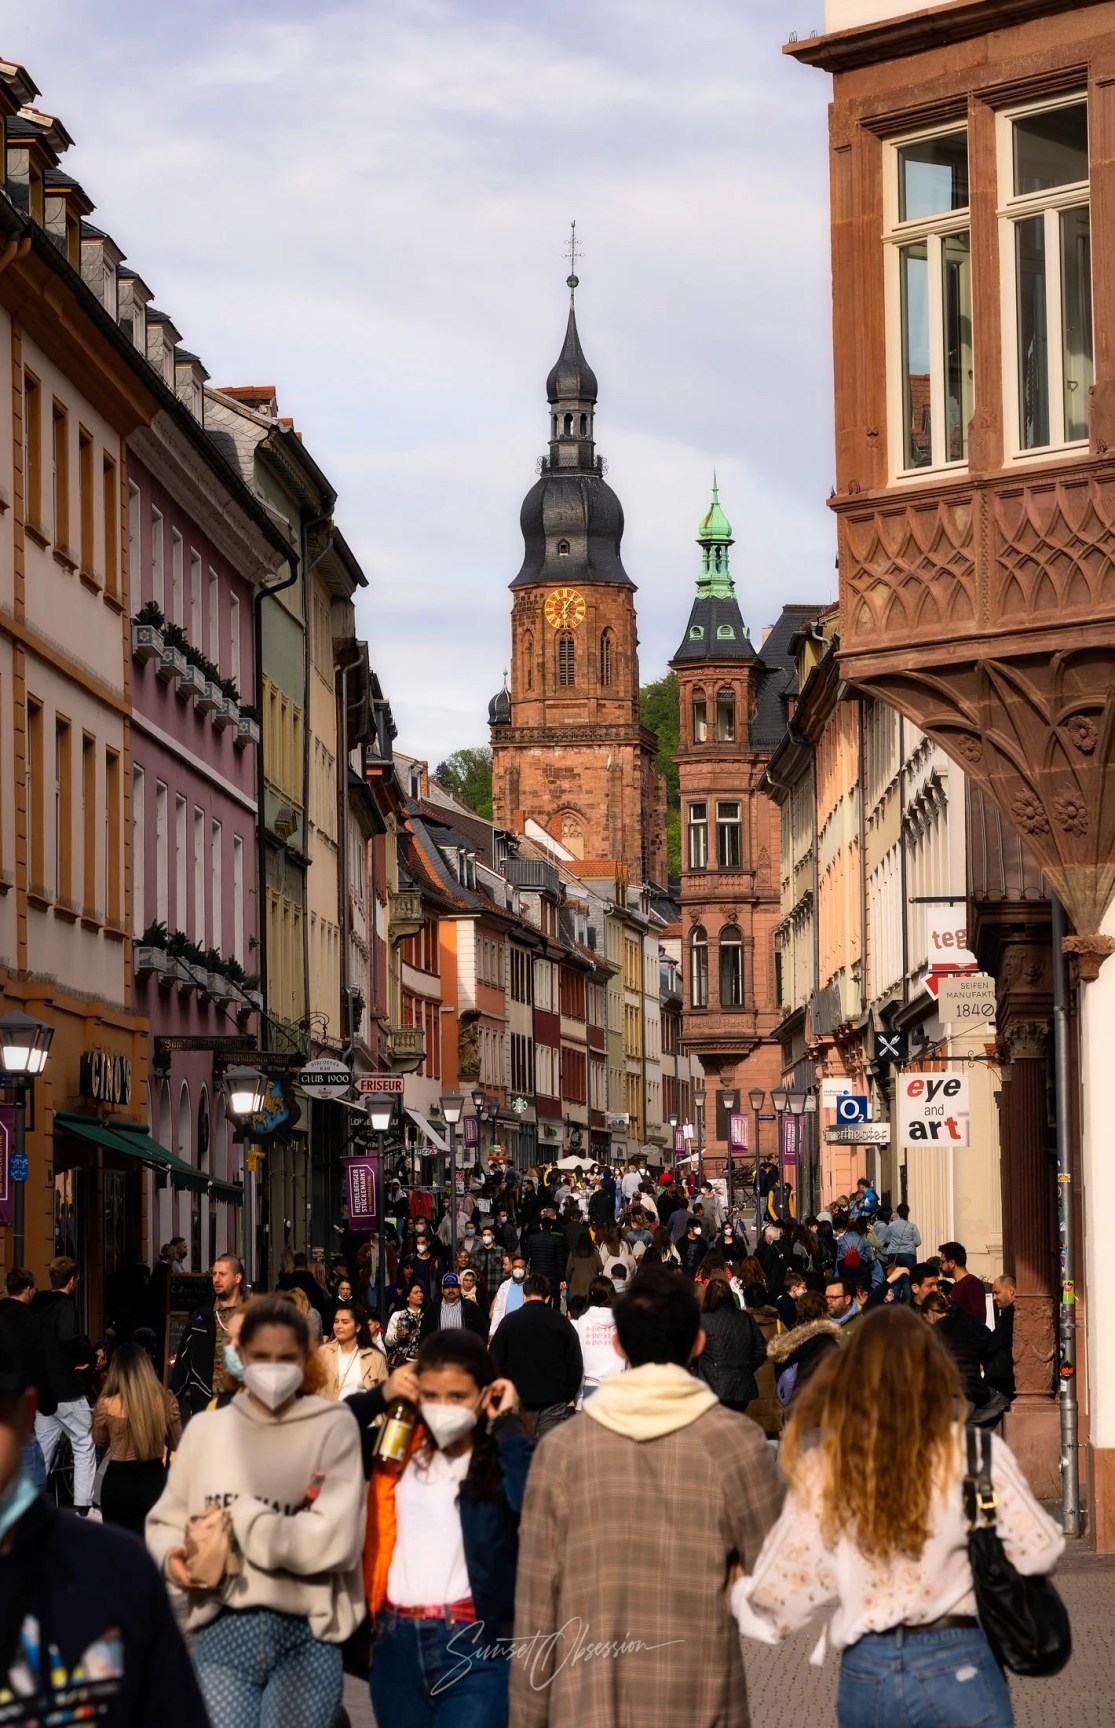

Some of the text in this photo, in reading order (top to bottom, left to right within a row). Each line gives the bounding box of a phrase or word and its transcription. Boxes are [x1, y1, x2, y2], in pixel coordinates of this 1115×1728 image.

[960, 982, 989, 990] SEIFEN
[301, 1074, 349, 1083] CLUB 1900
[360, 1080, 402, 1091] FRISEUR
[906, 1077, 962, 1102] eye
[924, 1105, 944, 1116] and
[908, 1116, 962, 1141] art
[352, 1168, 361, 1213] HEIDELBERGER
[359, 1168, 368, 1213] STÜCKEMARKT
